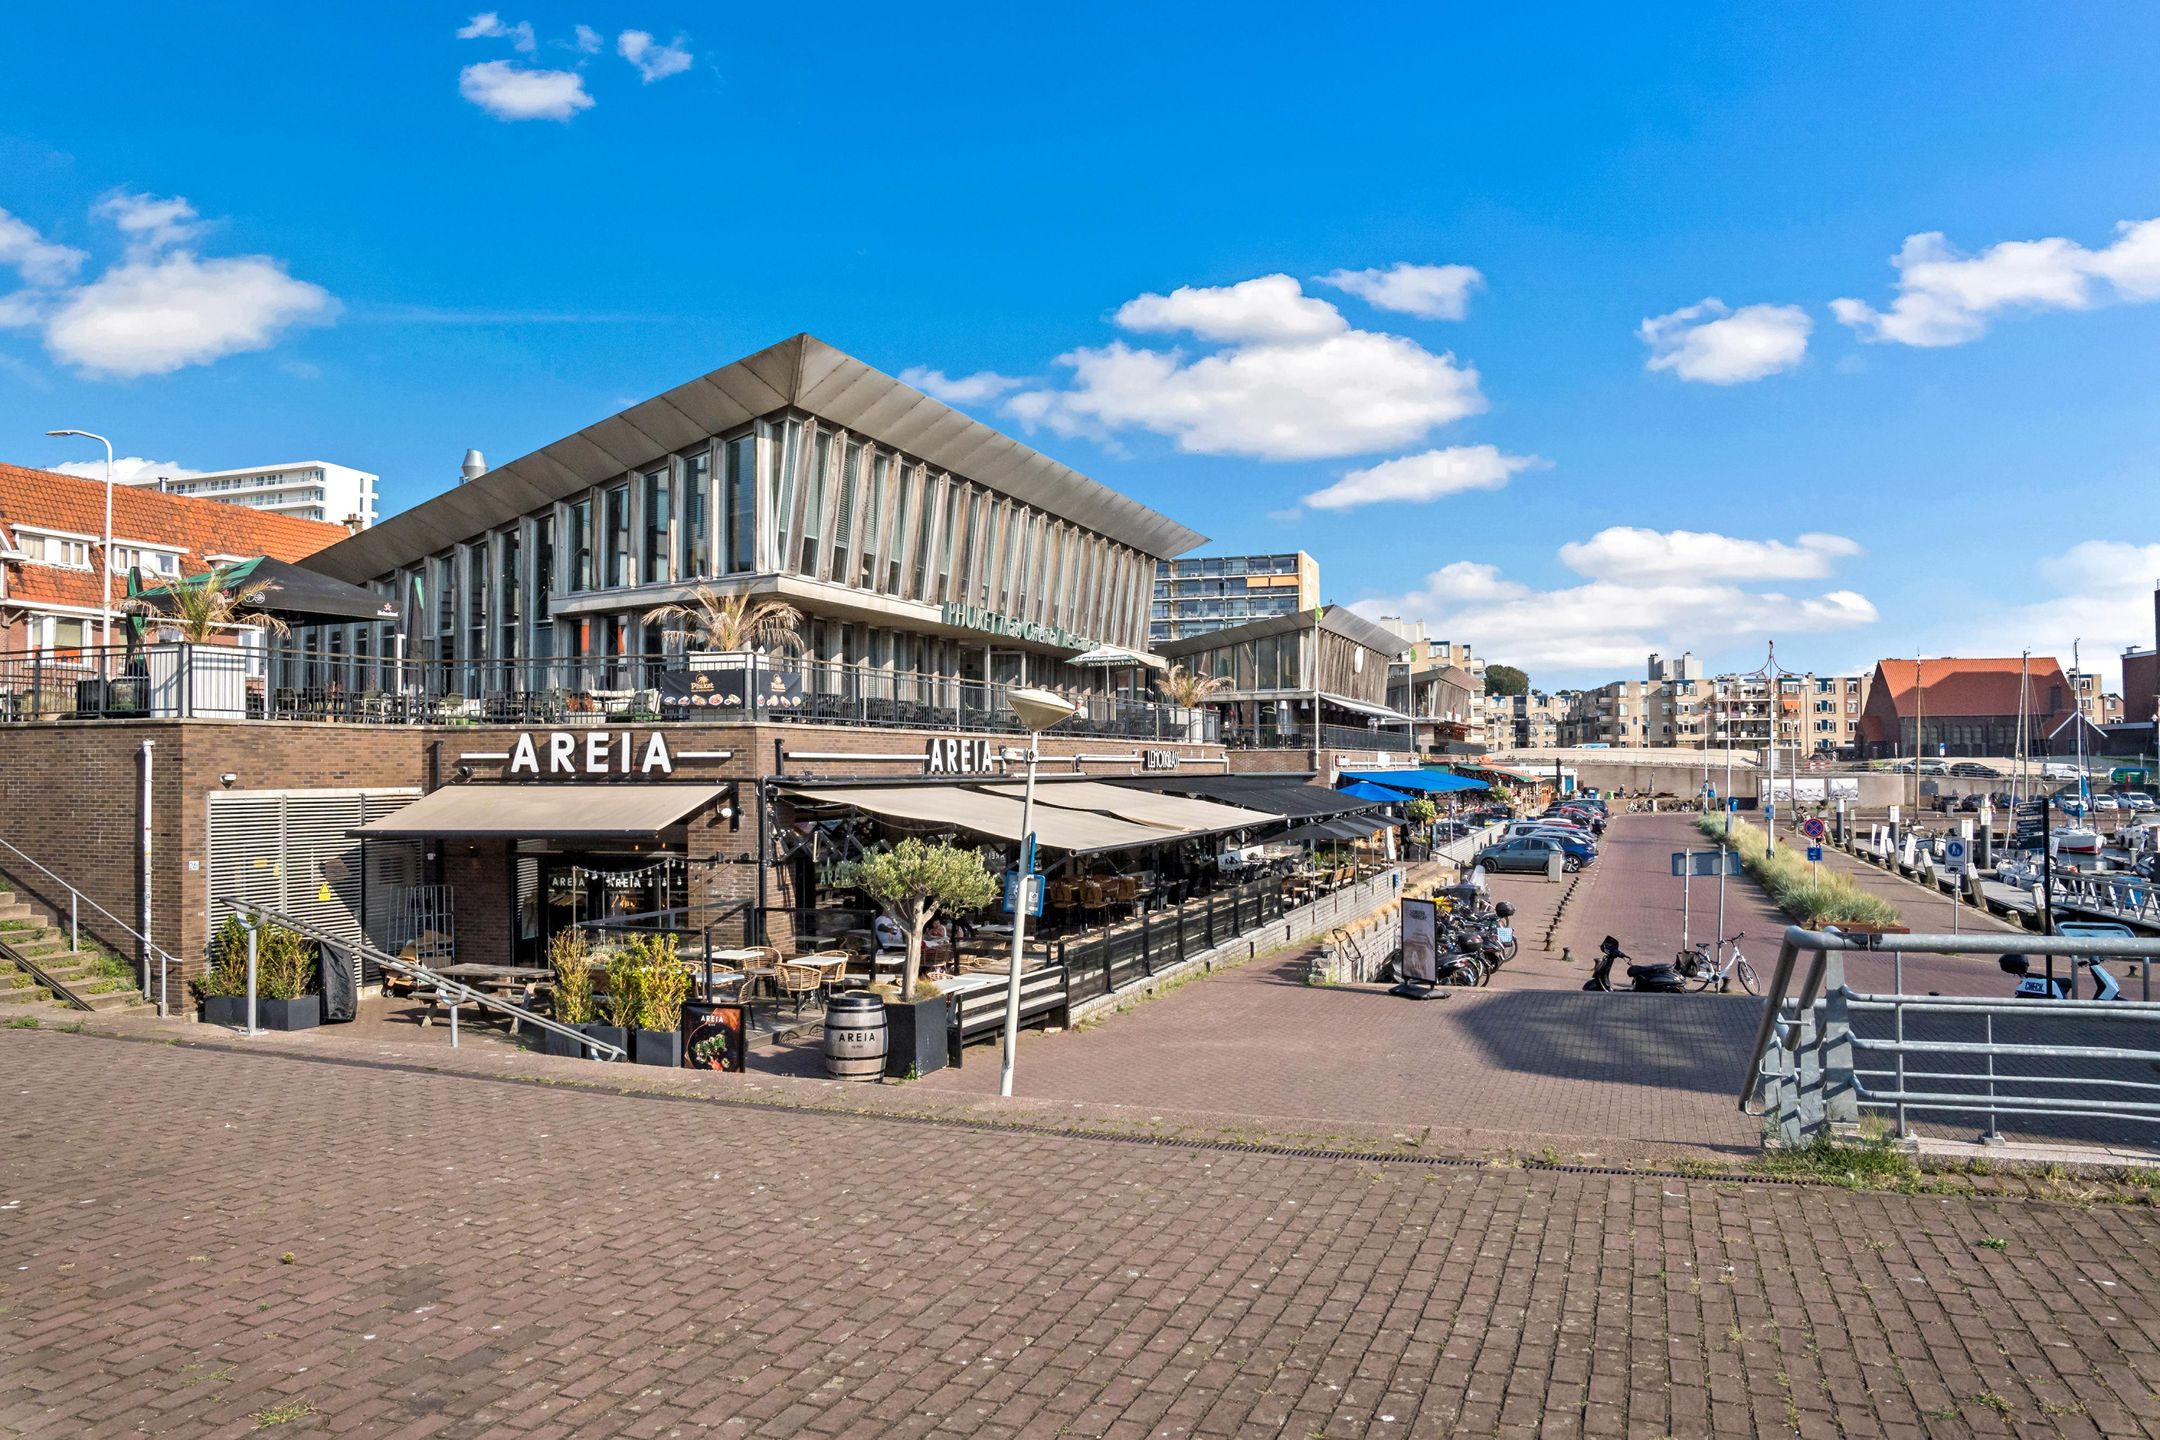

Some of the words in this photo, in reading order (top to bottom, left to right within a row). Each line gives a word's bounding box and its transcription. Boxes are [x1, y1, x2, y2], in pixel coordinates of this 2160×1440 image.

[945, 601, 997, 634] PHUKET
[1074, 654, 1129, 663] Heineken
[510, 731, 672, 774] AREIA
[930, 738, 993, 772] AREIA
[551, 877, 586, 887] AREA
[607, 878, 641, 888] AREIA
[700, 1014, 724, 1023] AREIA
[838, 1032, 875, 1042] AREIA
